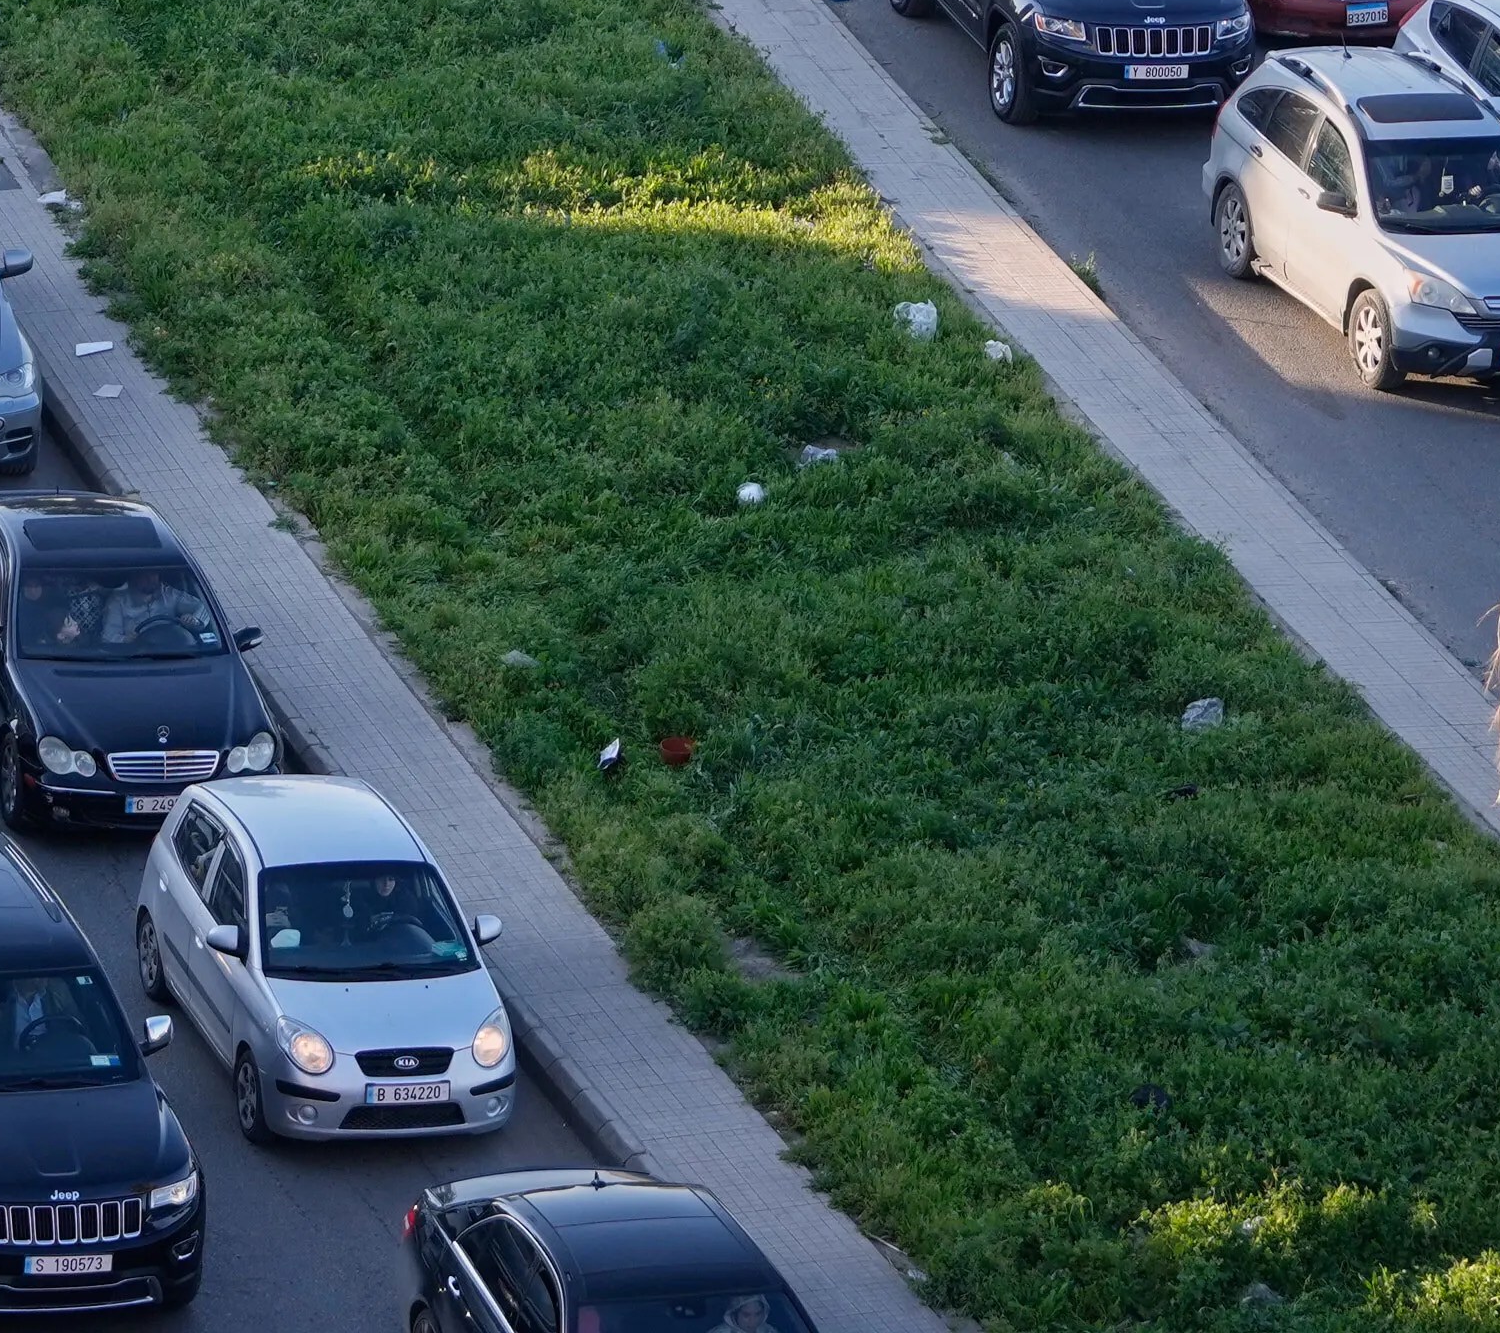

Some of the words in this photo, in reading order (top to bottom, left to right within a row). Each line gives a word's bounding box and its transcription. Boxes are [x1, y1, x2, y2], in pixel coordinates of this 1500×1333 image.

[1143, 15, 1166, 24] Jeep
[1347, 10, 1388, 24] B337016
[1132, 66, 1139, 78] Y
[1145, 65, 1182, 78] 800050
[136, 799, 145, 810] G
[376, 1089, 386, 1101] B
[393, 1086, 442, 1100] 634220
[50, 1189, 80, 1202] Jeep
[35, 1259, 44, 1272] S
[54, 1257, 104, 1271] 190573
